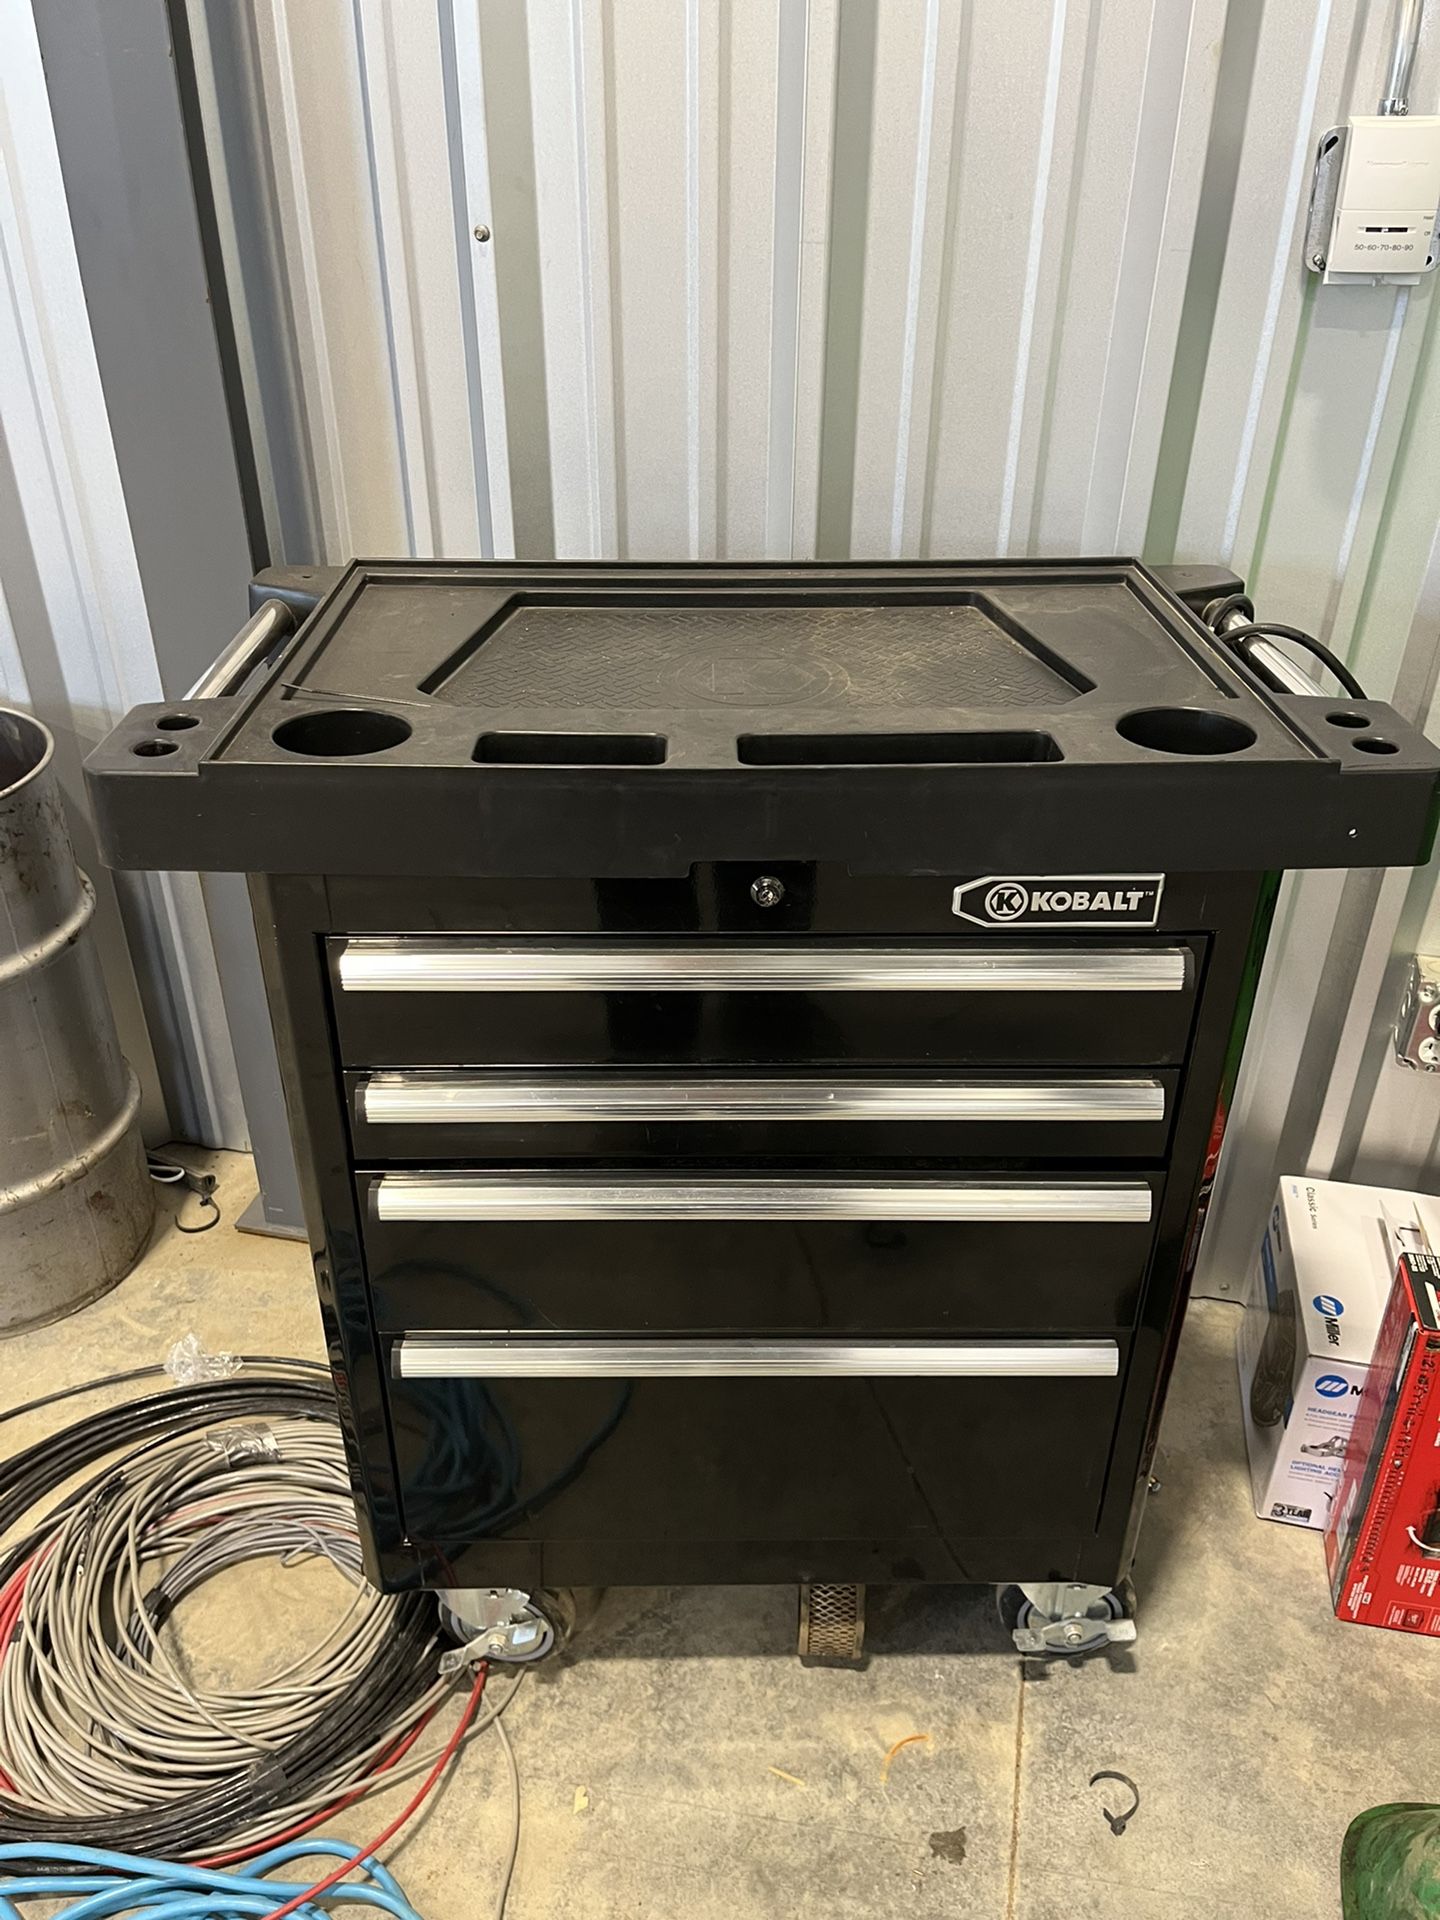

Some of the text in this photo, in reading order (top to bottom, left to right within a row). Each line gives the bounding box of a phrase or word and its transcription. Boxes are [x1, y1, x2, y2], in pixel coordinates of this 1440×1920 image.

[1030, 890, 1144, 912] KOBALT
[1306, 1186, 1318, 1212] Classic
[1324, 1317, 1339, 1347] Miller
